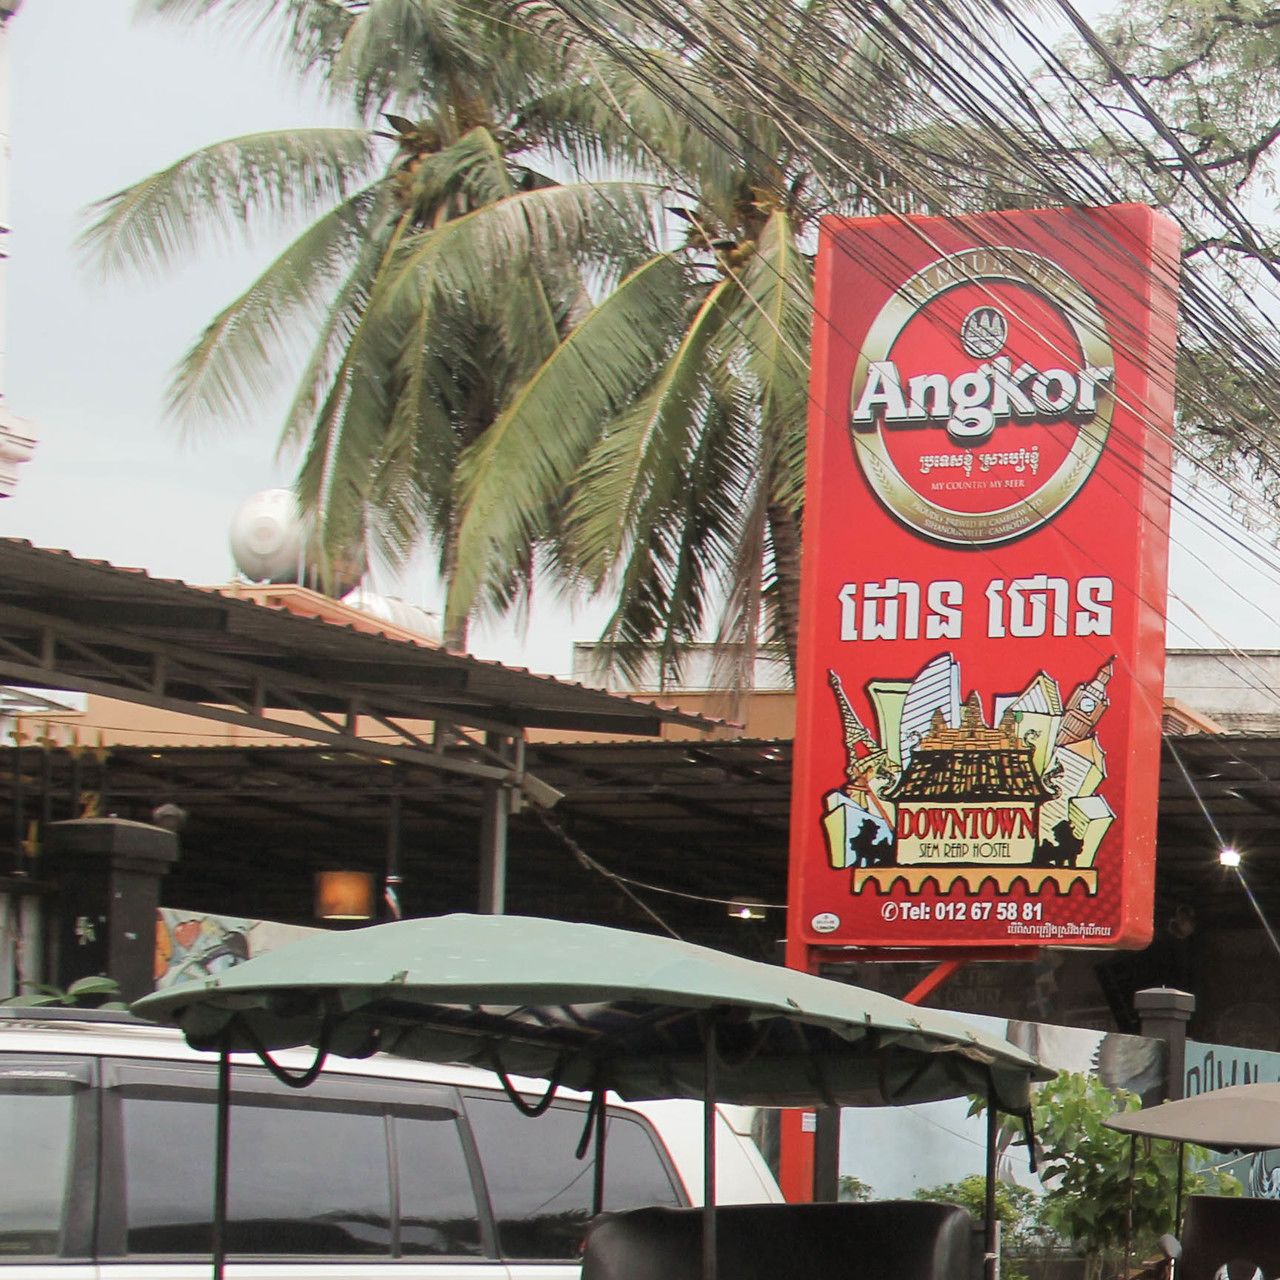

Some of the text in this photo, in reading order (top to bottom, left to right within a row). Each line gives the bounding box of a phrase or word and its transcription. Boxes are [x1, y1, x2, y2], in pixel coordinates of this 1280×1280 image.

[852, 356, 1114, 438] Angkor
[931, 482, 944, 490] MY
[898, 807, 1036, 841] DOWNTOWN
[919, 841, 1012, 859] SIEM REAP HOSTEL
[900, 902, 1043, 921] Tel: 012 67 58 81
